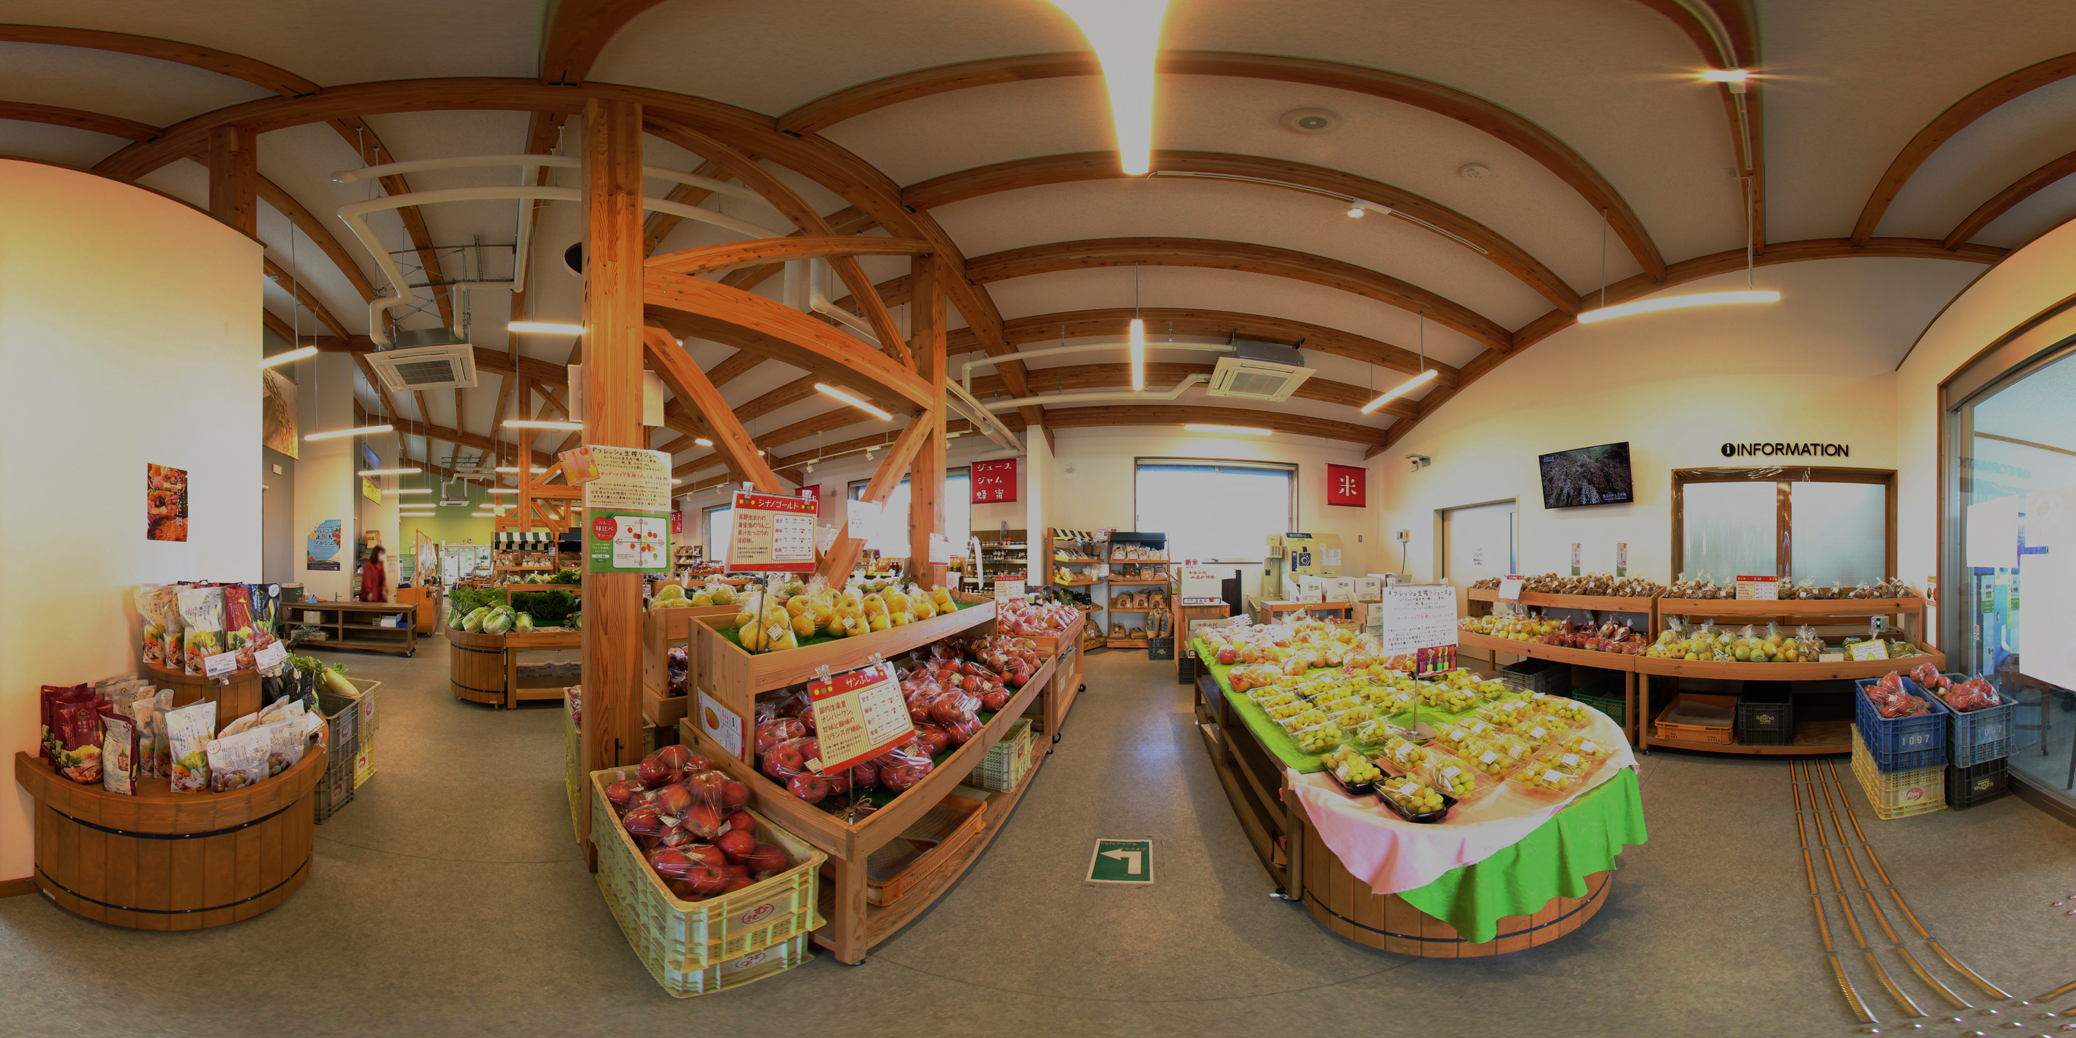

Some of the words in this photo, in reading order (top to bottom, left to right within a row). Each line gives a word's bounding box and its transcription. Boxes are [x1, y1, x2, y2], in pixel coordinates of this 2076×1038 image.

[1737, 443, 1849, 457] INFORMATION
[977, 462, 1012, 472] ジュース
[977, 476, 1003, 485] ジャム
[1337, 474, 1357, 497] 米
[758, 499, 799, 510] シナノゴールド
[1978, 725, 2003, 738] 1097
[1902, 734, 1931, 746] 1097
